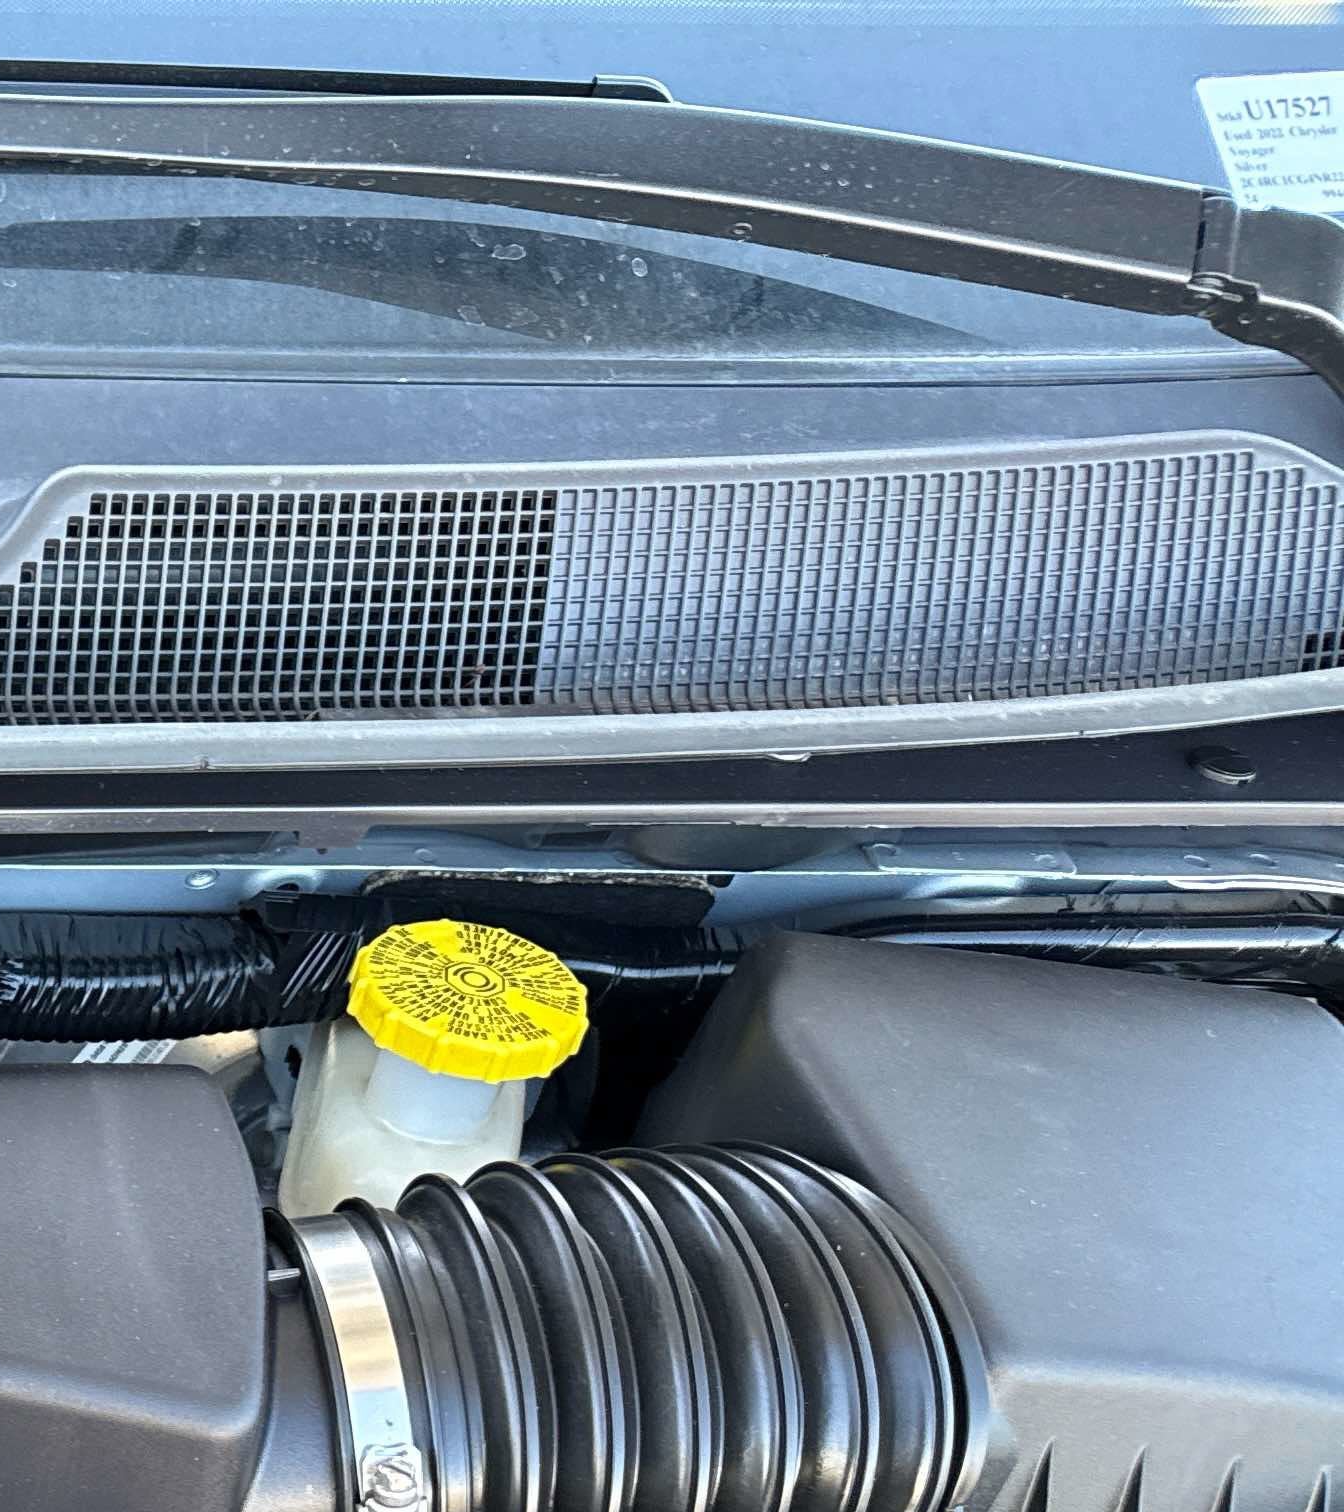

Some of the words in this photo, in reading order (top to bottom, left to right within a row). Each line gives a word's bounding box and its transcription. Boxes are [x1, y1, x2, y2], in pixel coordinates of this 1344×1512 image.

[1243, 96, 1331, 121] U17527
[1289, 124, 1338, 141] Chrysler
[463, 938, 535, 968] REMOVING
[535, 951, 575, 982] SEALED
[401, 979, 470, 1022] UNIQUEMENT
[413, 969, 466, 1012] PROVENANT
[433, 983, 510, 1007] CONTENANT
[400, 994, 441, 1019] AVANT
[477, 1011, 533, 1025] UTILISER
[446, 1016, 539, 1033] REMPLISSAGE
[518, 1026, 554, 1041] MISE
